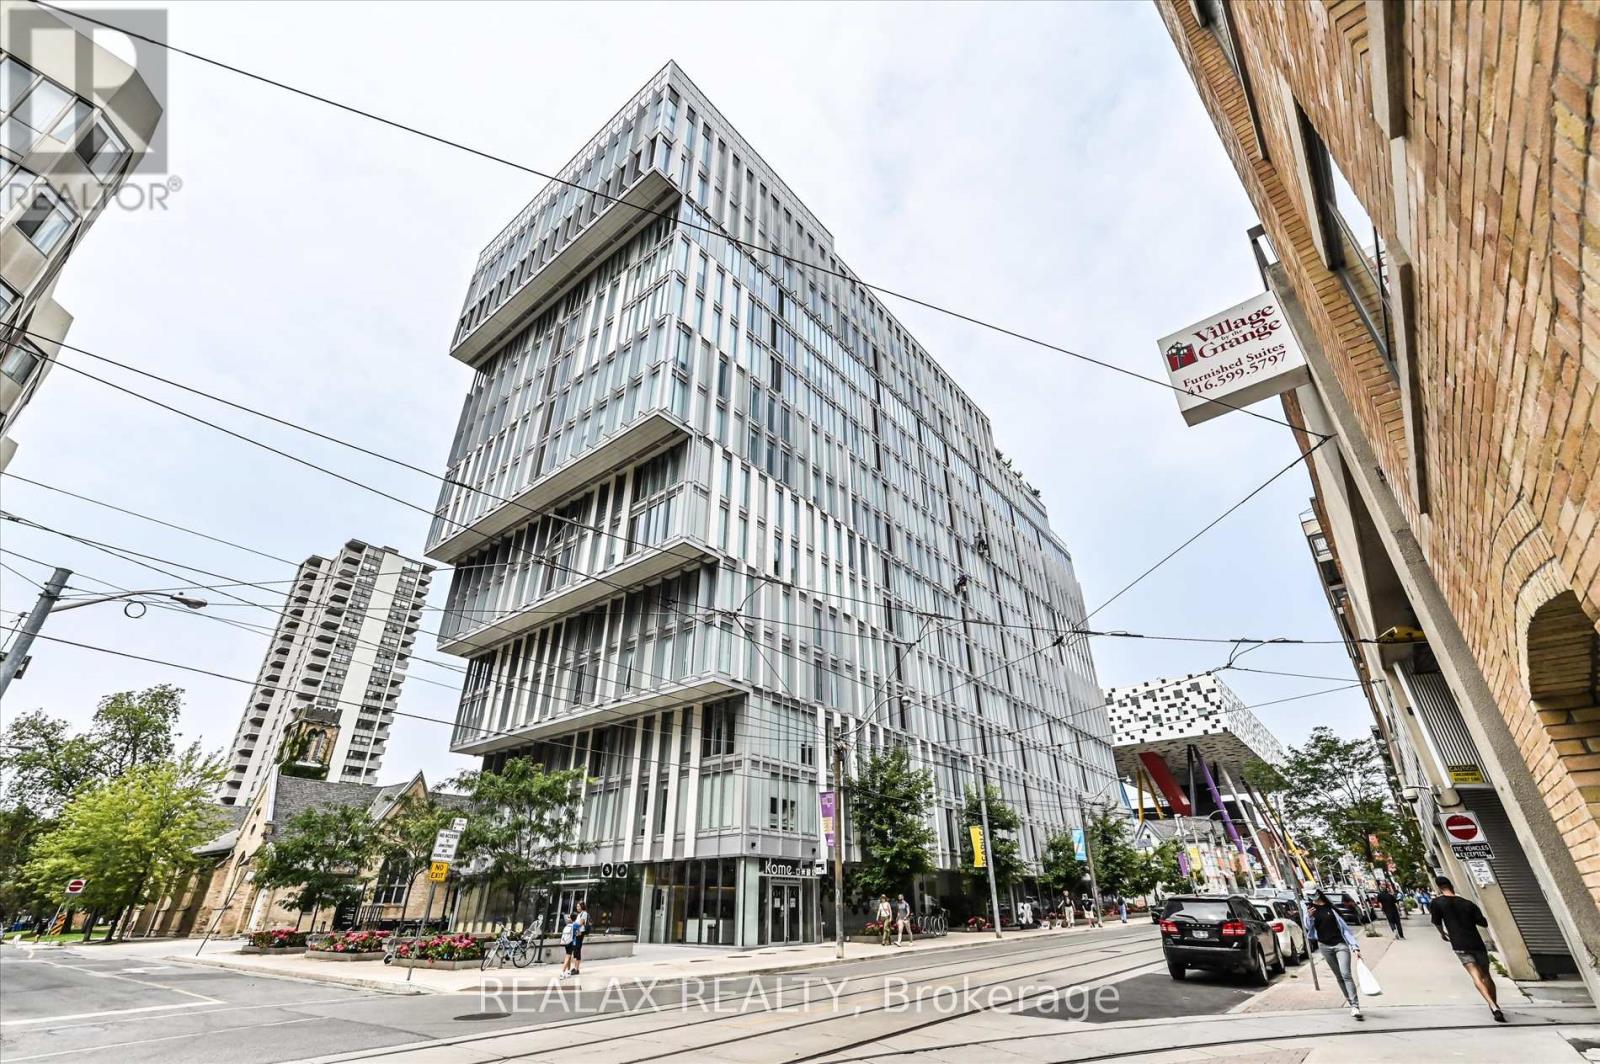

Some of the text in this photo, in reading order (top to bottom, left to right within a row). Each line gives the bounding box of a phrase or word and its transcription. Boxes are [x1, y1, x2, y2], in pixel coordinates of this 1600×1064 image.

[1192, 304, 1276, 343] Village
[1198, 319, 1283, 359] Grange
[1220, 328, 1243, 342] by the
[1183, 343, 1285, 388] Furnished Suites
[1187, 350, 1287, 396] 416.599.5797
[765, 860, 792, 875] Kome
